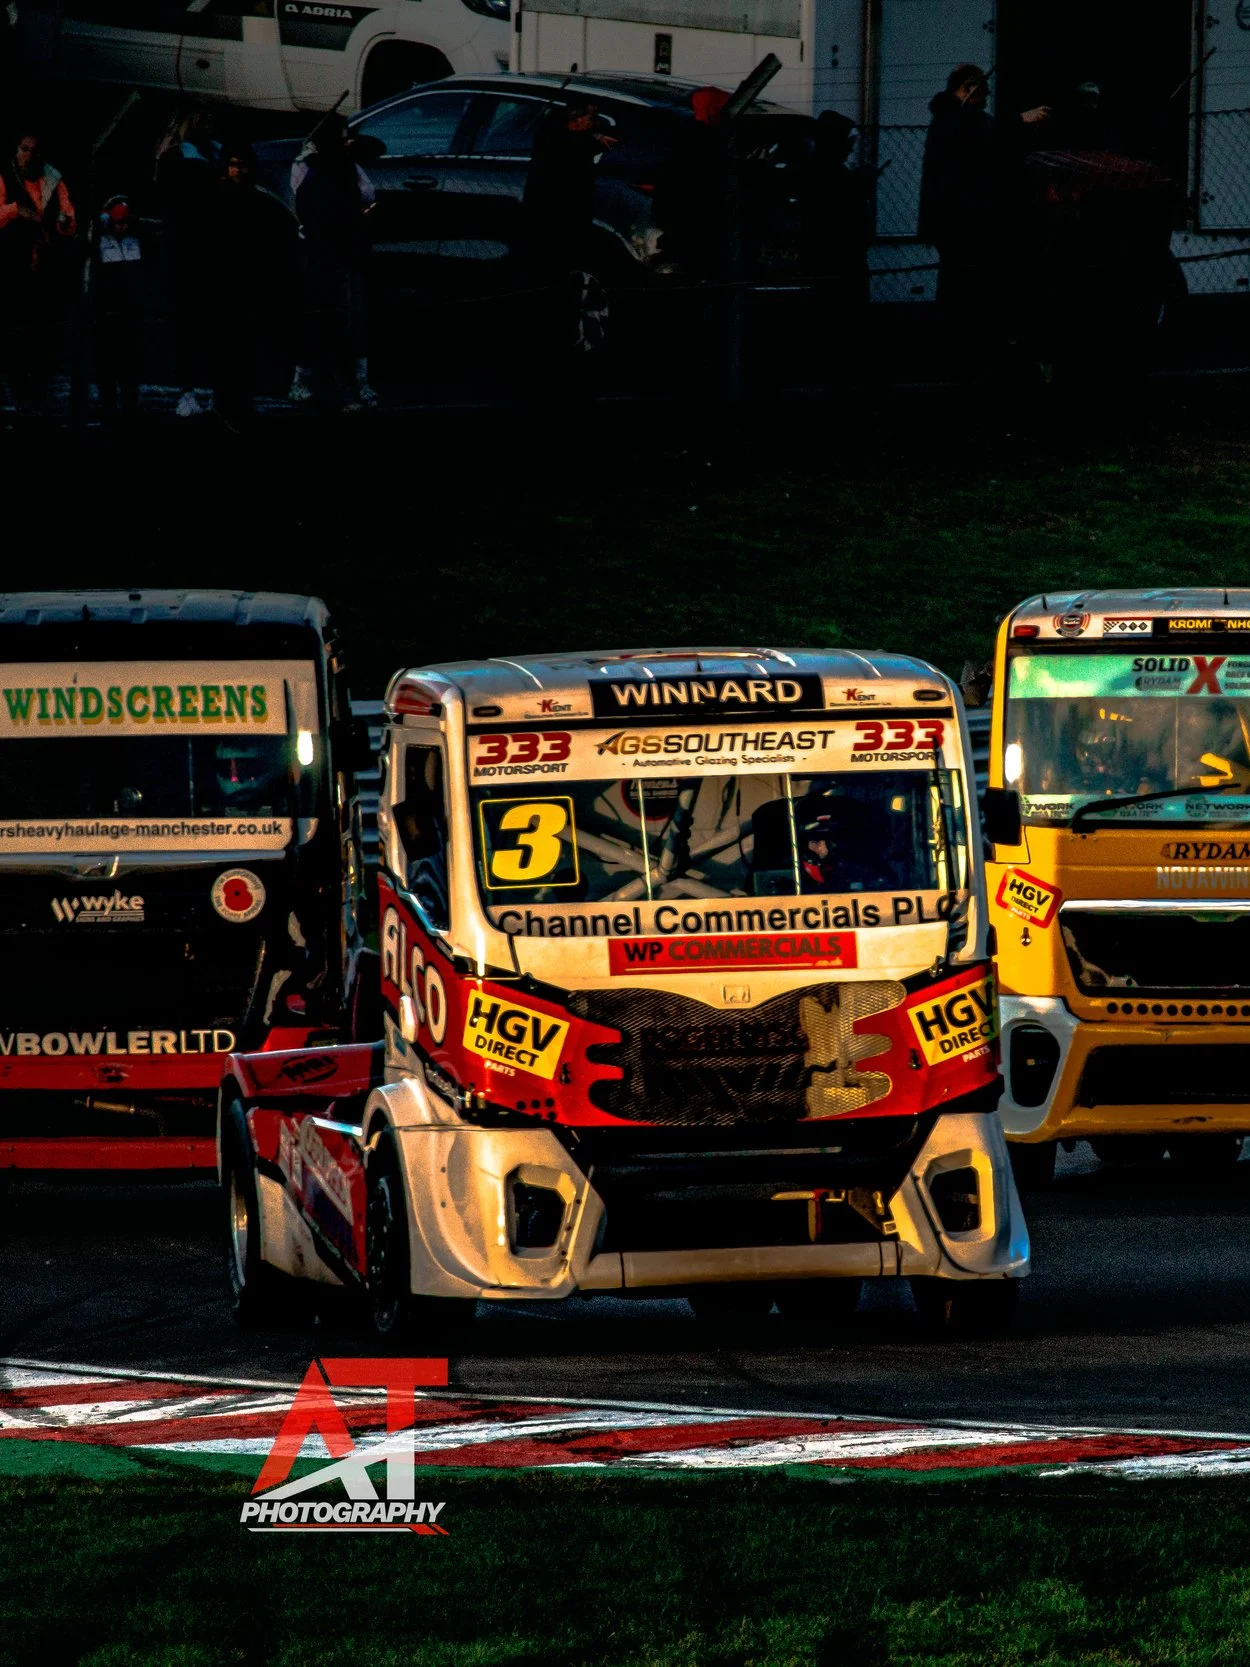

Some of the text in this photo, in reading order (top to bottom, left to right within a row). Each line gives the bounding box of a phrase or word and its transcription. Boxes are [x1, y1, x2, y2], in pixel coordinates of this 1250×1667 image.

[302, 5, 353, 19] ADRIA
[1132, 657, 1190, 672] SOLID
[3, 684, 269, 726] WINDSCREENS
[611, 680, 803, 705] WINNARD
[475, 731, 572, 766] 333
[852, 720, 945, 752] 333
[473, 762, 569, 777] MOTORSPORT
[632, 754, 796, 768] Automotive Glazing Specialists
[850, 751, 938, 763] MOTORSPOR
[491, 803, 568, 881] 3
[80, 888, 145, 915] wyke
[1009, 878, 1051, 906] HGV
[499, 907, 642, 937] Channel
[654, 900, 880, 934] Commercials
[624, 938, 842, 963] WP COMMERCIALS
[469, 996, 562, 1052] HGV
[915, 980, 994, 1042] HGV
[474, 1033, 540, 1068] DIRECT
[961, 1045, 992, 1062] PARTS
[484, 1058, 517, 1077] PARTS
